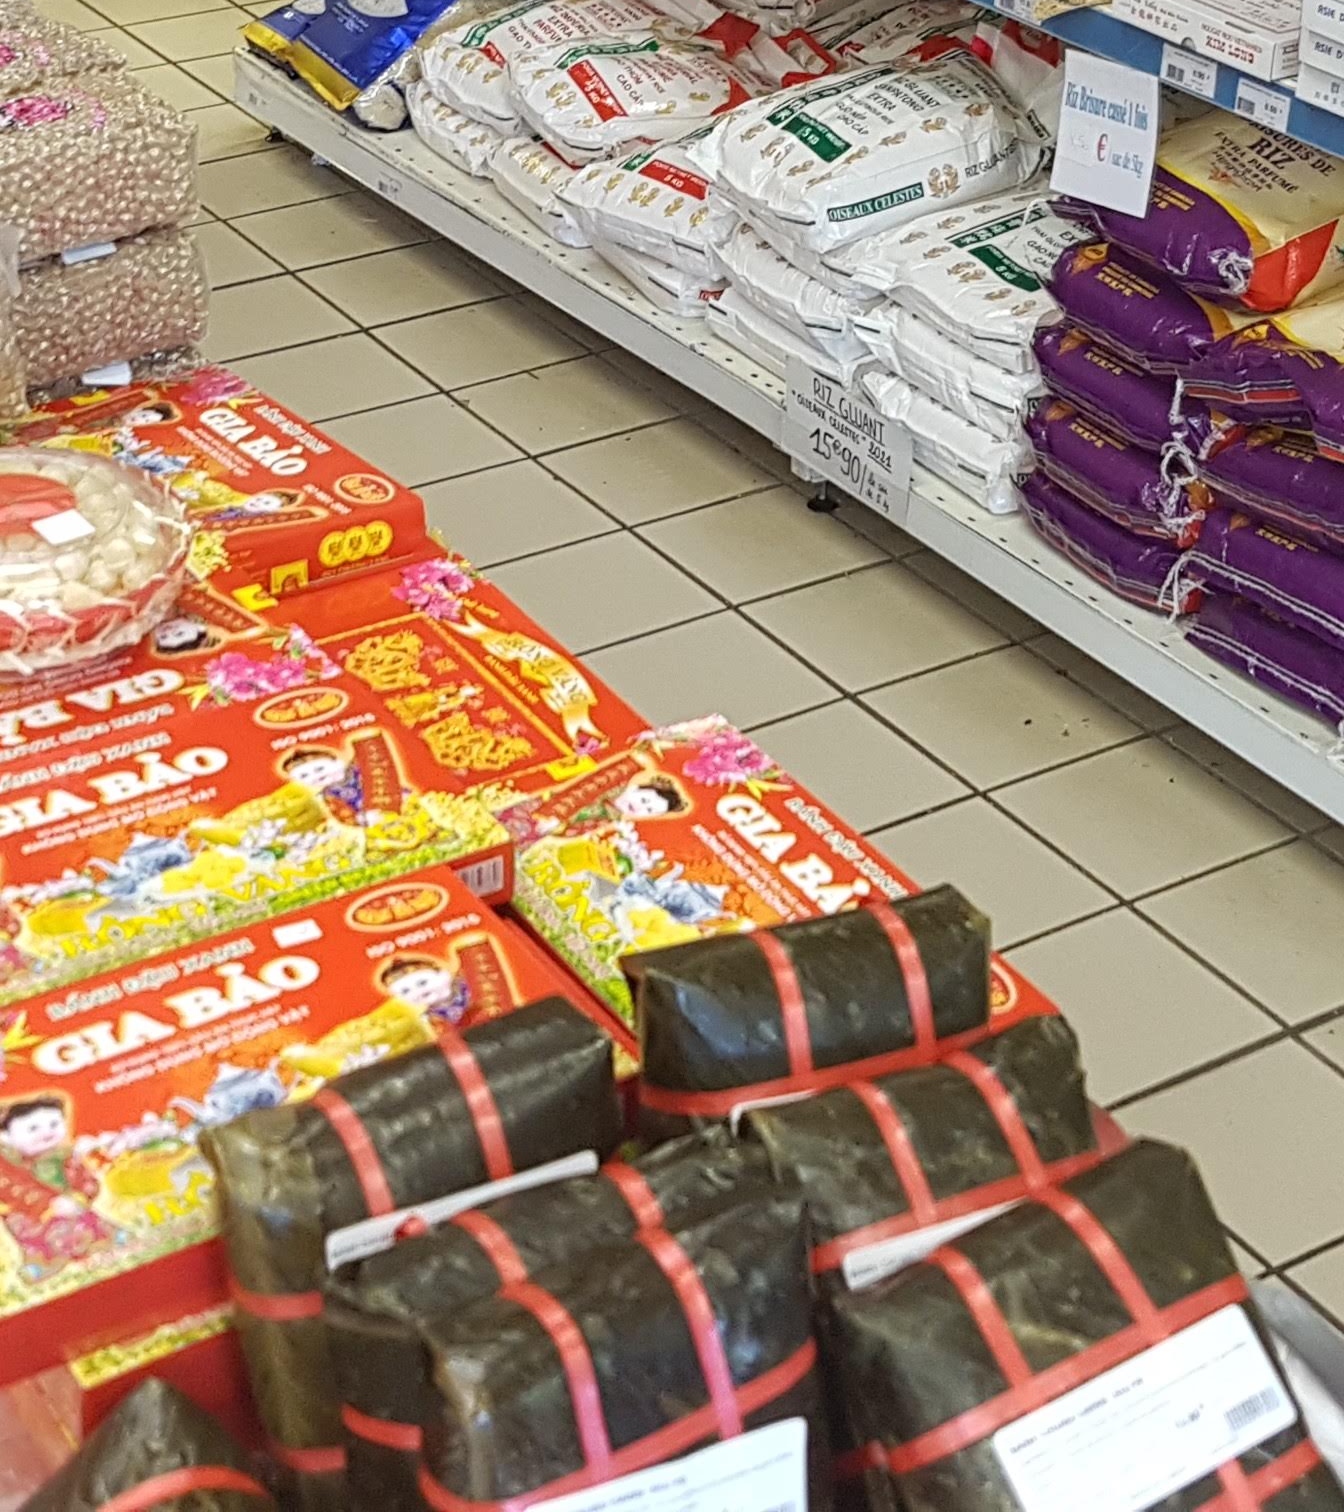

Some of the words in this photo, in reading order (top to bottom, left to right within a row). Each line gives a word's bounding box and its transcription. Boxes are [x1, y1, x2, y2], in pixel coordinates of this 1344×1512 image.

[1078, 86, 1107, 120] Brisure
[1106, 94, 1127, 125] cassé
[1214, 129, 1247, 159] EXTRA
[1247, 136, 1295, 171] RIZ
[964, 163, 979, 178] RIZ
[1312, 157, 1337, 178] DE
[829, 198, 874, 222] OISEAUX
[875, 184, 924, 212] CELESTES
[813, 377, 835, 409] RIZ
[839, 397, 886, 448] GLUANT
[199, 407, 256, 444] GIA
[237, 435, 309, 477] BẢO
[64, 667, 186, 712] GIA
[86, 745, 230, 806] BẢO
[715, 792, 799, 865] GIA
[777, 850, 872, 917] BẢ
[31, 1010, 178, 1076] GIA
[162, 954, 321, 1030] BẢO
